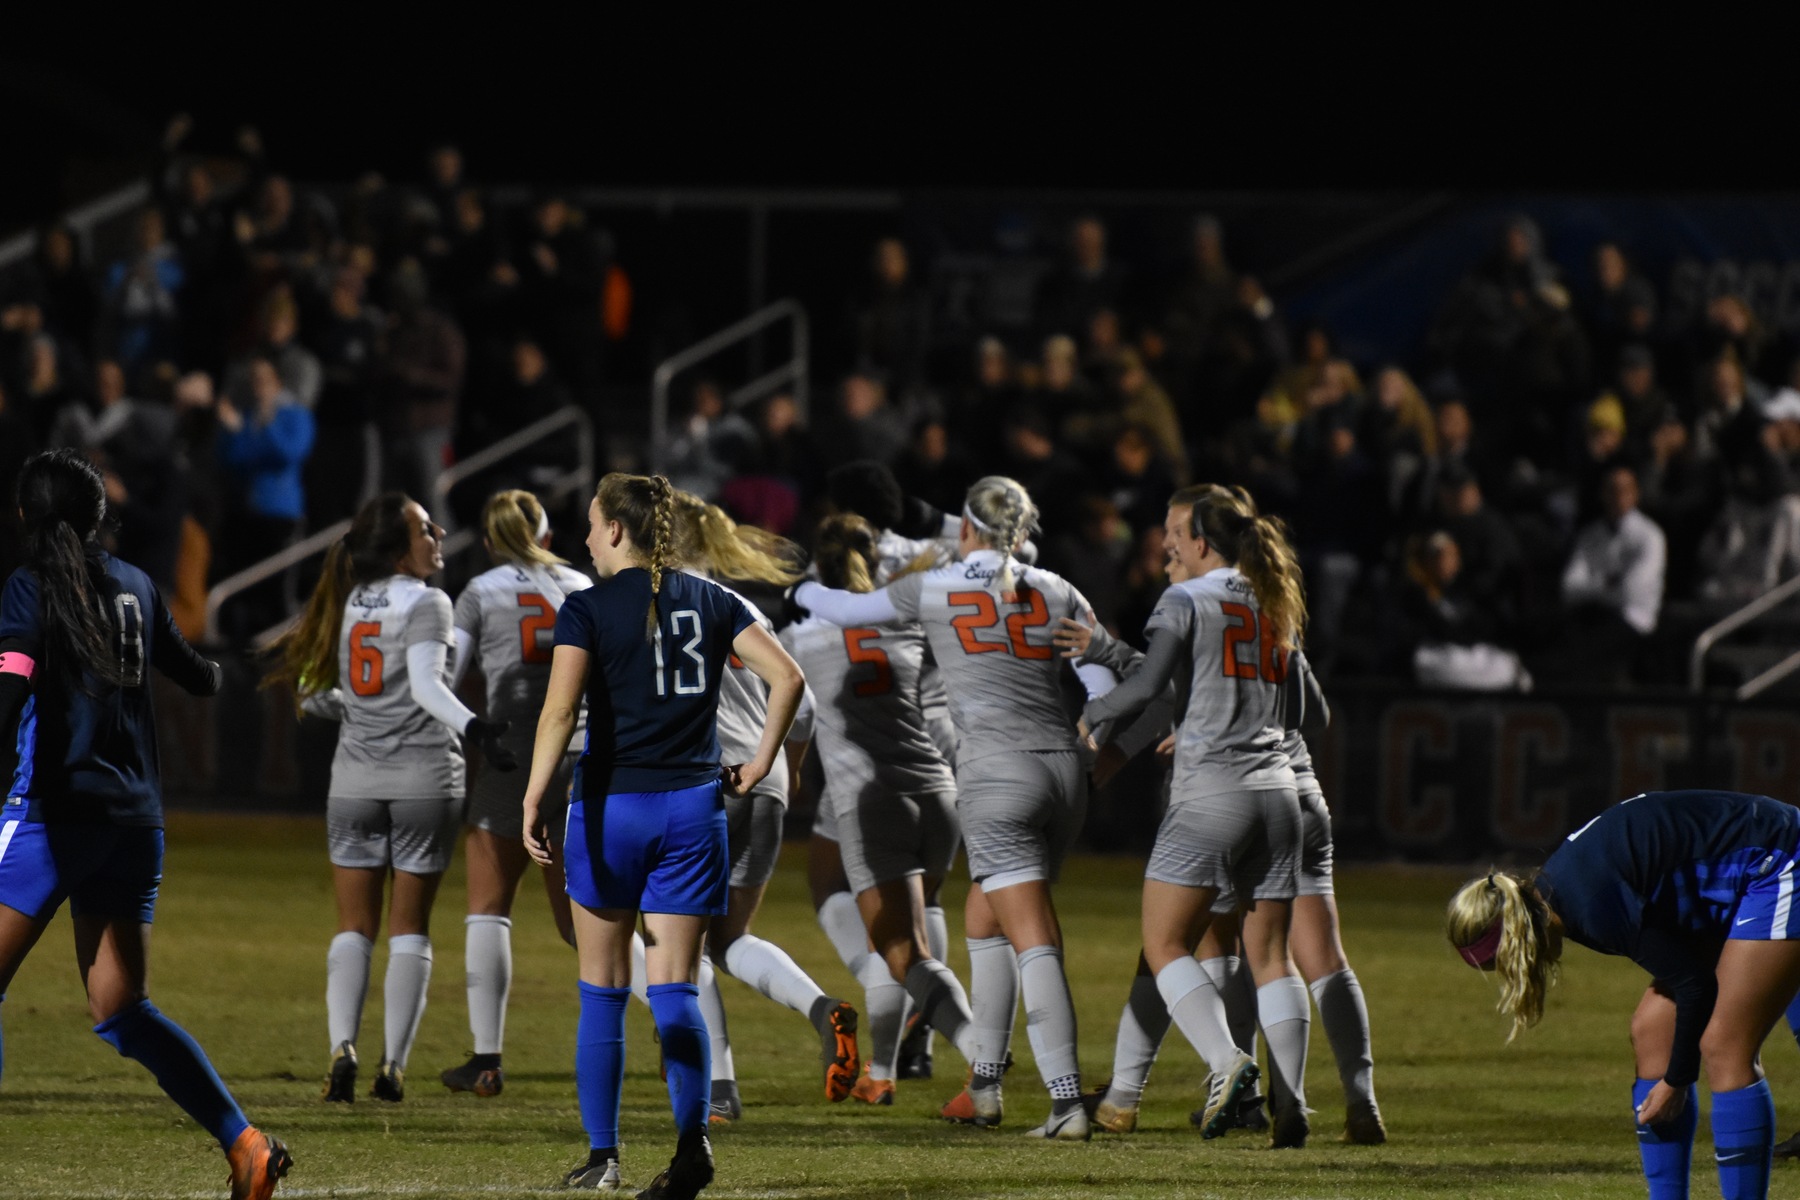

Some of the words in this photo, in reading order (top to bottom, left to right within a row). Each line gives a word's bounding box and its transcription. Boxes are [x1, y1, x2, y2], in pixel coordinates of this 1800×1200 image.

[348, 620, 384, 697] 6
[517, 593, 557, 664] 2
[654, 609, 706, 696] 13
[947, 587, 1053, 660] 22
[842, 626, 893, 698] 5
